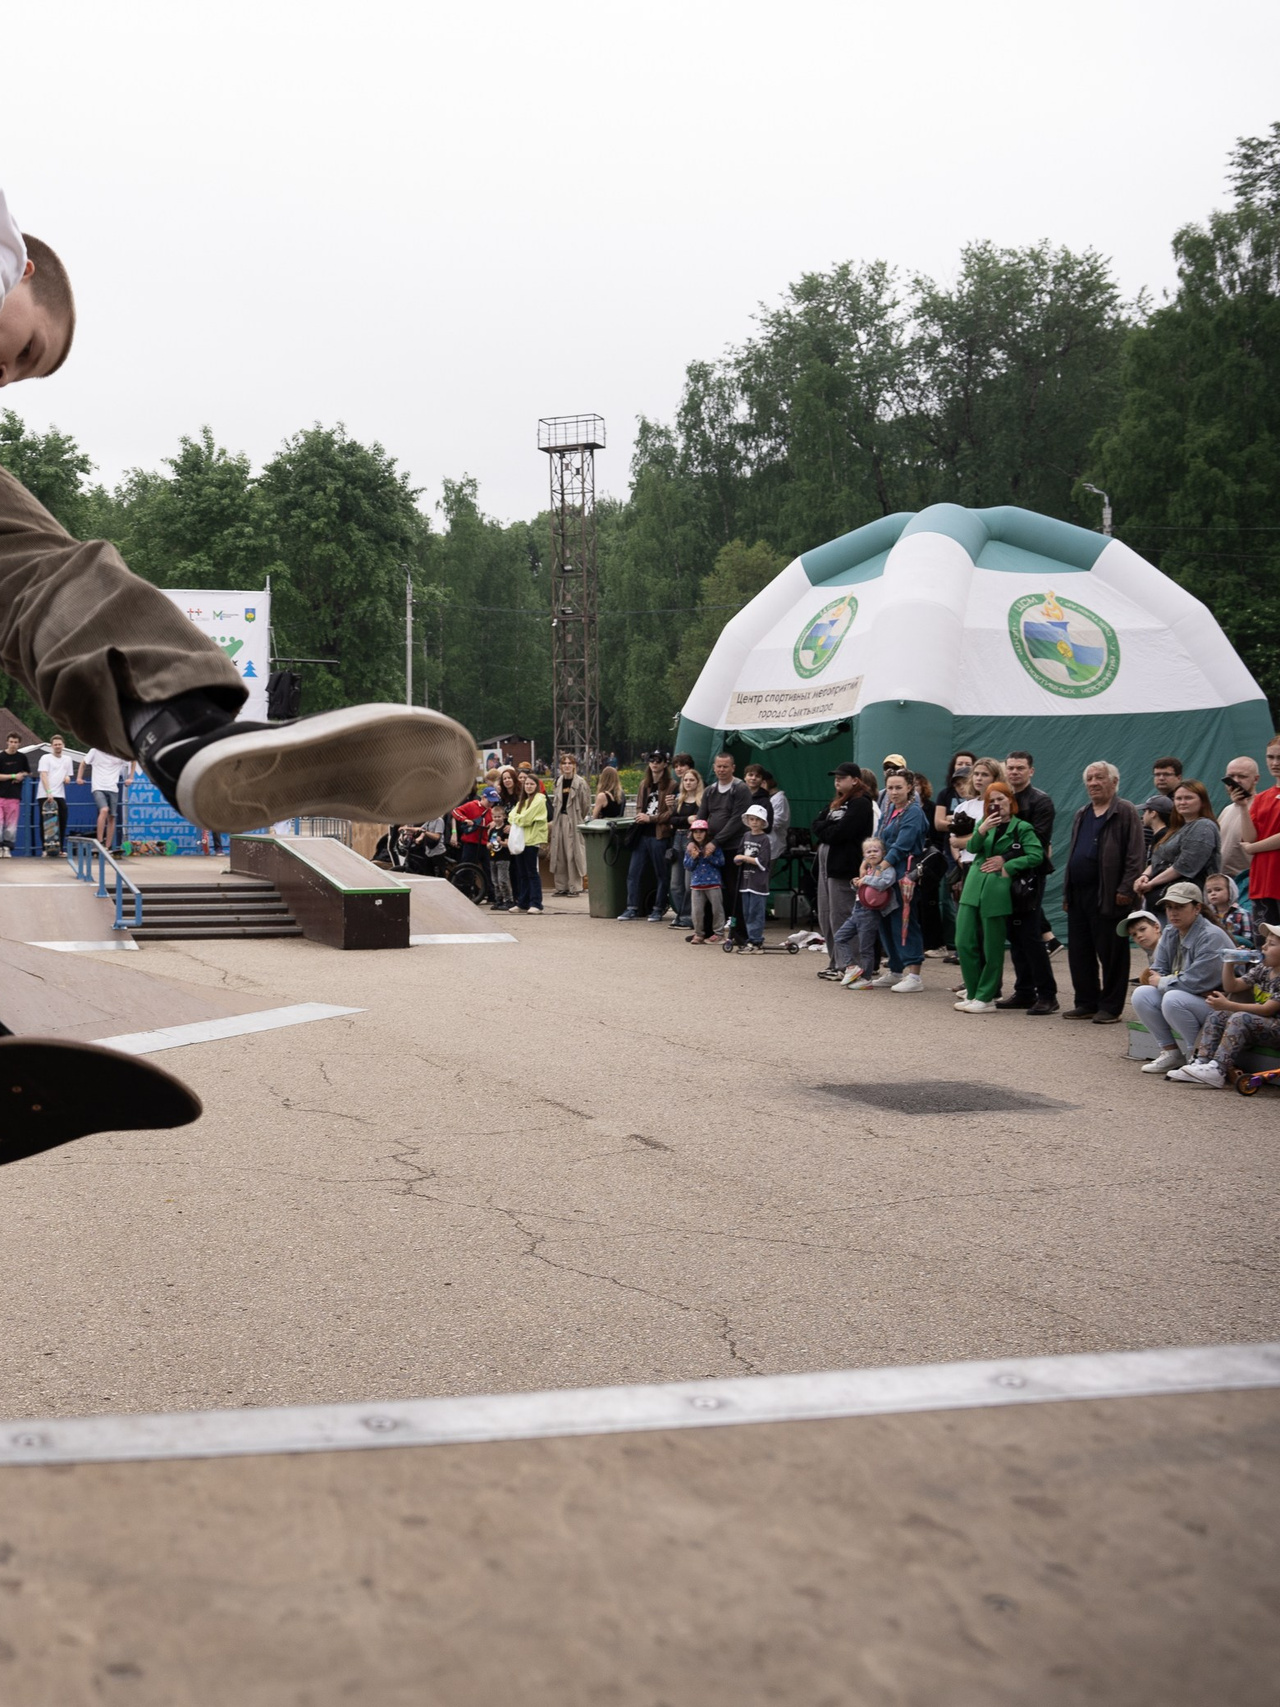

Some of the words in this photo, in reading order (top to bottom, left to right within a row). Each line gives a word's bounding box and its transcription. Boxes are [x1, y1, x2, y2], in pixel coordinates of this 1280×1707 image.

[1014, 596, 1039, 612] ЦСМ
[736, 692, 763, 705] Центр
[764, 692, 811, 705] спортивных
[812, 677, 859, 700] мероприятий
[757, 709, 787, 720] города
[787, 702, 834, 718] Сыктывкара
[128, 792, 154, 804] АРТ
